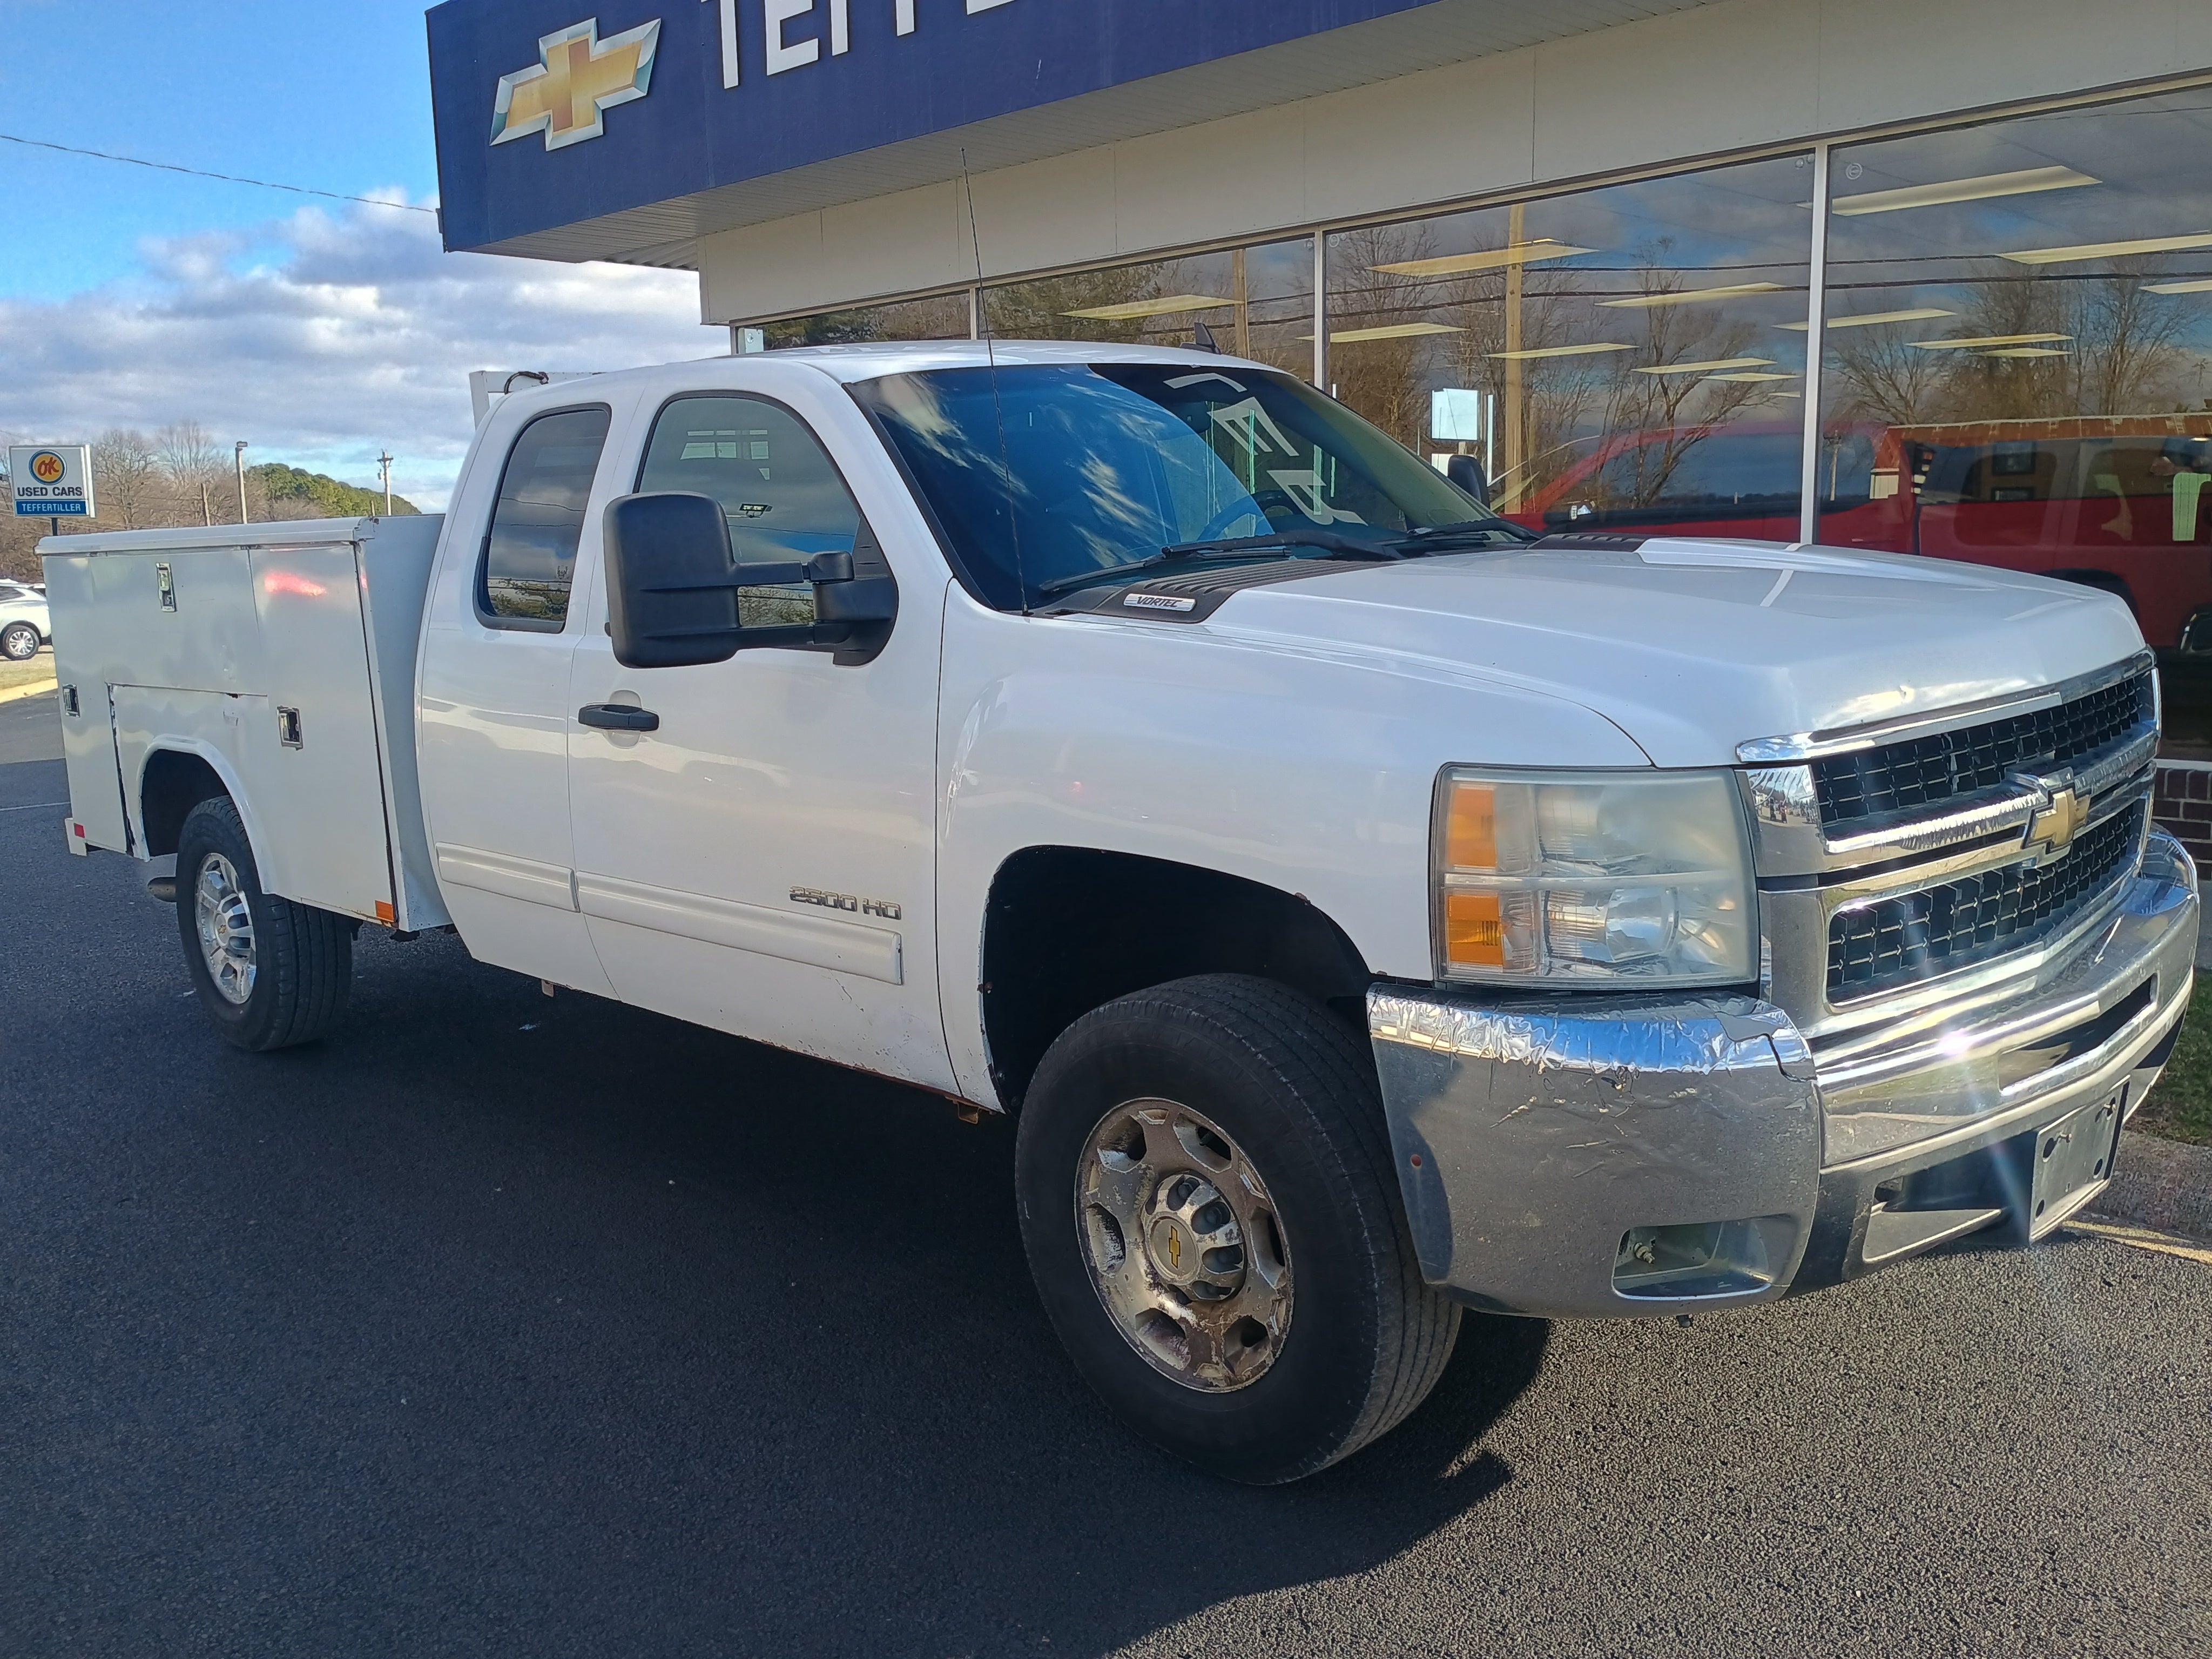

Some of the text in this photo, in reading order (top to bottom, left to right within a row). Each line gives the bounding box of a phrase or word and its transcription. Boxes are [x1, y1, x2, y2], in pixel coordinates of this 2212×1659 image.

[37, 457, 59, 476] OK
[17, 487, 83, 496] USED CARS
[22, 503, 81, 511] TEFFERTILLER
[1136, 596, 1183, 608] VORTEC
[789, 886, 901, 920] 2500 HD
